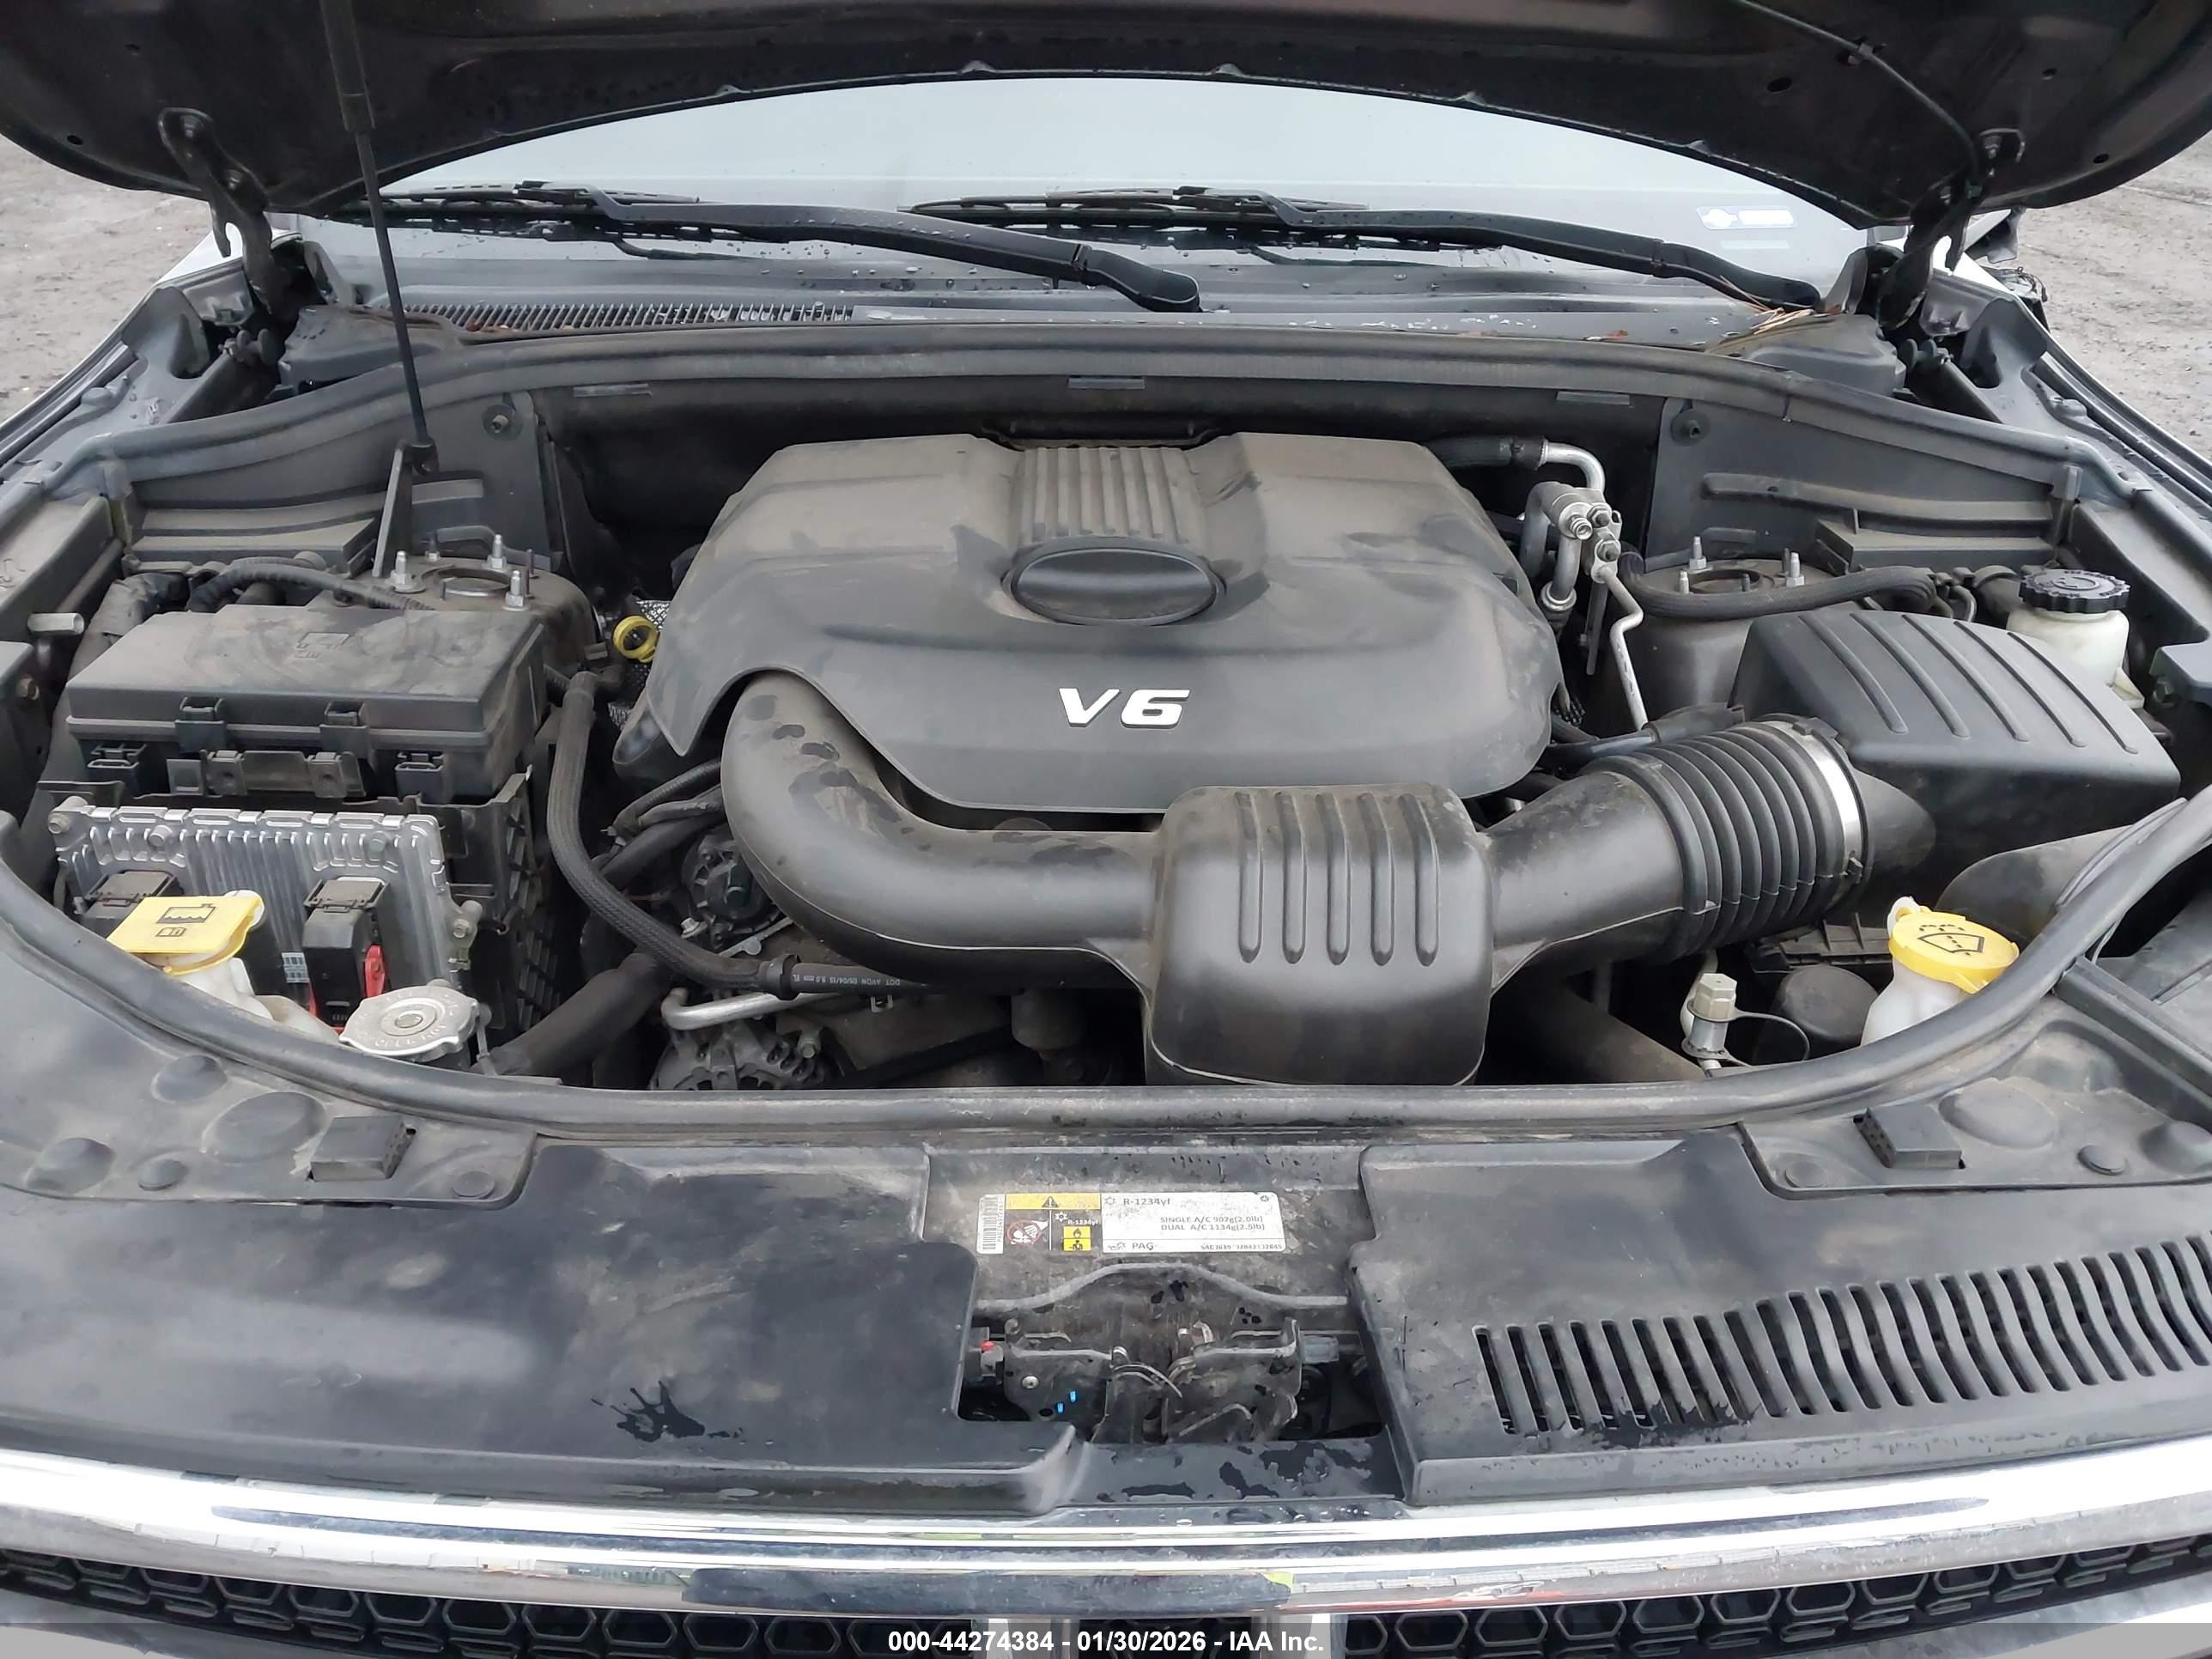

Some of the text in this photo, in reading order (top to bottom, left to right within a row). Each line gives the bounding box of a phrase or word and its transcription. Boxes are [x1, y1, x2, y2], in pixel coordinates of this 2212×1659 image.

[1058, 687, 1191, 729] V6
[1122, 1197, 1171, 1207] R-1234yf
[1132, 1242, 1154, 1251] PAG
